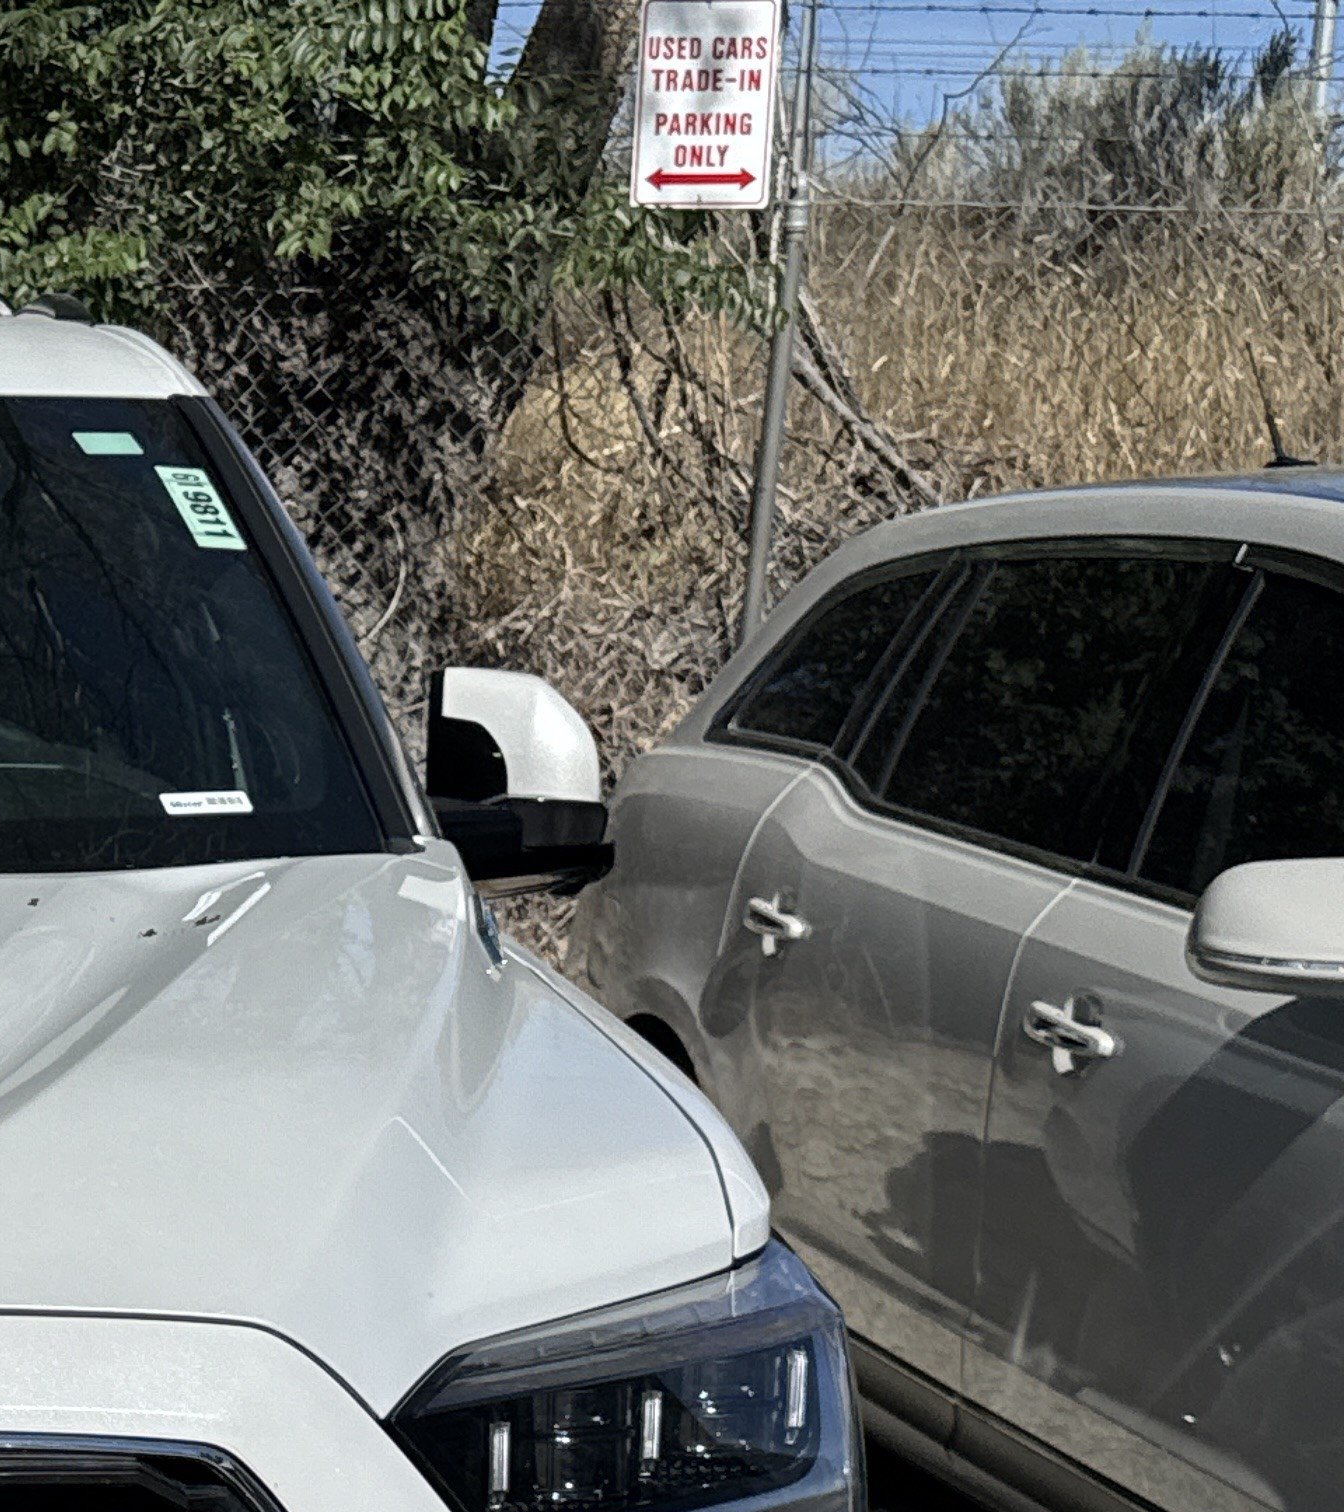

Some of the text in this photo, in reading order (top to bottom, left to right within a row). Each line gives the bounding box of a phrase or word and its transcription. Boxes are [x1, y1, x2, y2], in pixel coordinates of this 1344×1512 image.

[648, 36, 768, 60] USED CARS
[651, 69, 762, 92] TRADE-IN
[654, 112, 753, 136] PARKING
[674, 144, 730, 167] ONLY
